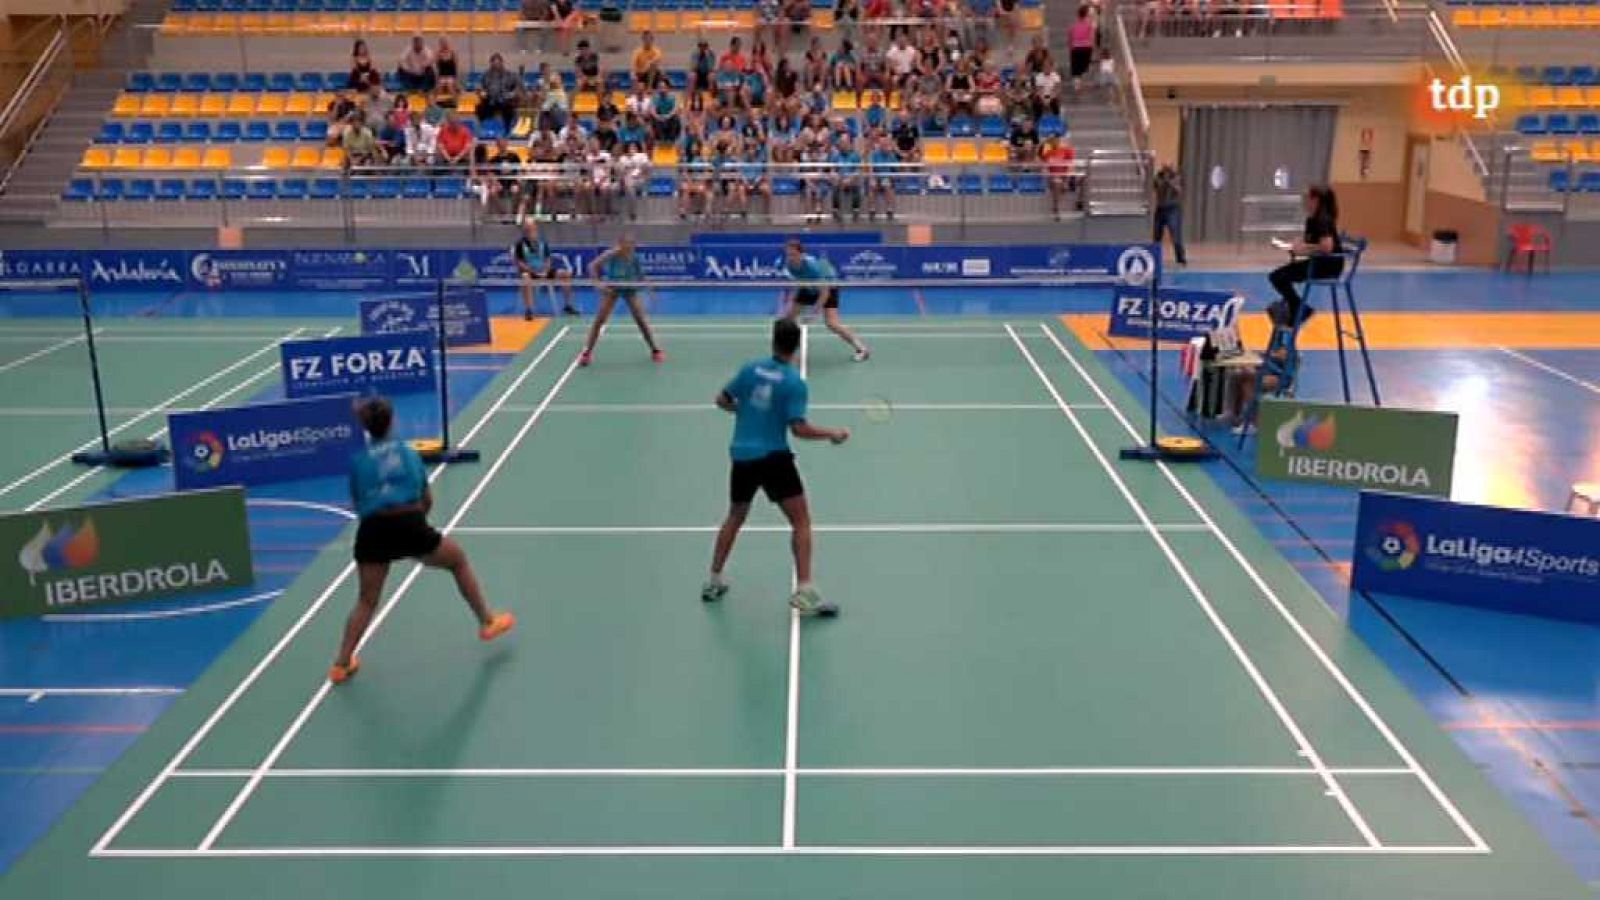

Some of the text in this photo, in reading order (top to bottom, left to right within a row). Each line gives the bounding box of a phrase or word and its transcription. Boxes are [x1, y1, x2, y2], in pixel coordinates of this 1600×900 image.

[1118, 297, 1144, 316] FZ
[290, 356, 323, 380] FZ
[331, 347, 426, 377] FORZA
[1288, 456, 1431, 488] IBERDROLA
[1426, 534, 1600, 576] LaLiga4Sports
[45, 558, 229, 606] IBERDROLA
